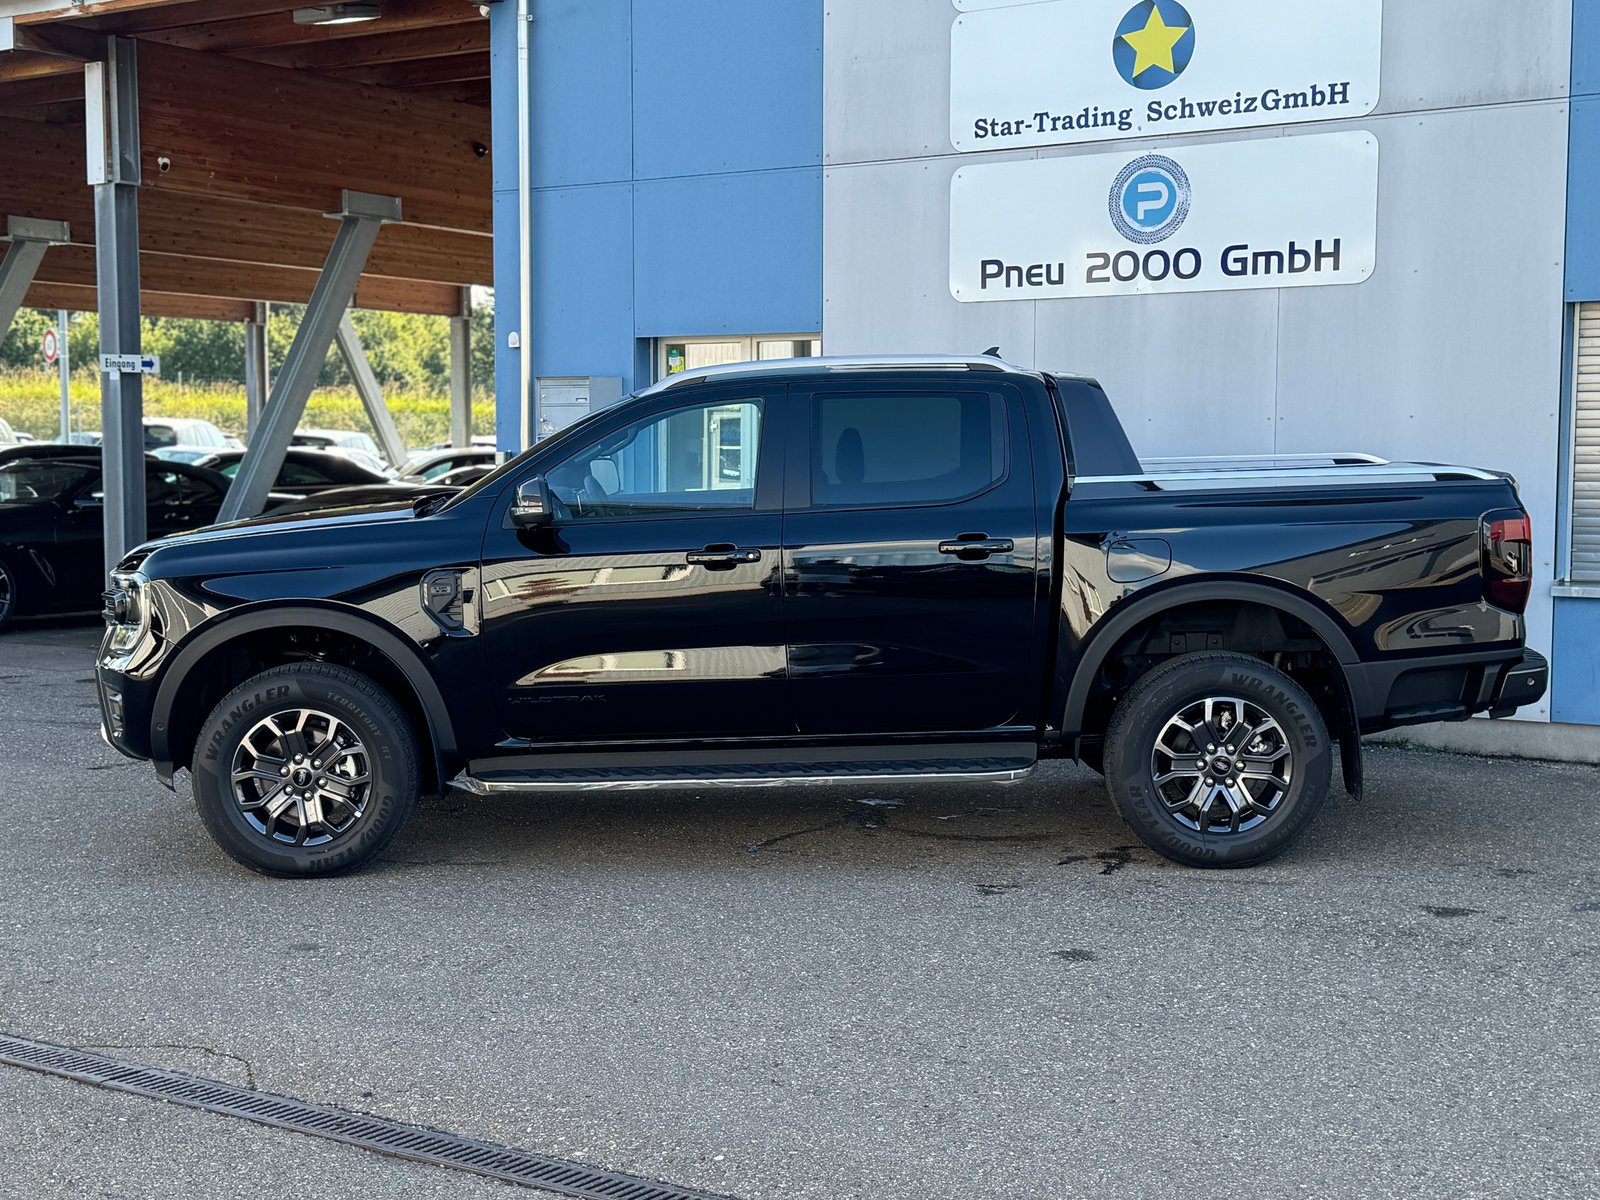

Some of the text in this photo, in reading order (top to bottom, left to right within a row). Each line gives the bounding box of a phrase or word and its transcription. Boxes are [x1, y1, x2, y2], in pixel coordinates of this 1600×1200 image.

[974, 105, 1133, 139] Star-Trading
[1137, 182, 1169, 220] P
[979, 238, 1341, 290] Pneu 2000 GmbH
[105, 357, 136, 371] Eingang
[205, 684, 291, 763] WRANGLER
[326, 691, 383, 738] TERRITORY
[1231, 672, 1318, 749] WRANGLER
